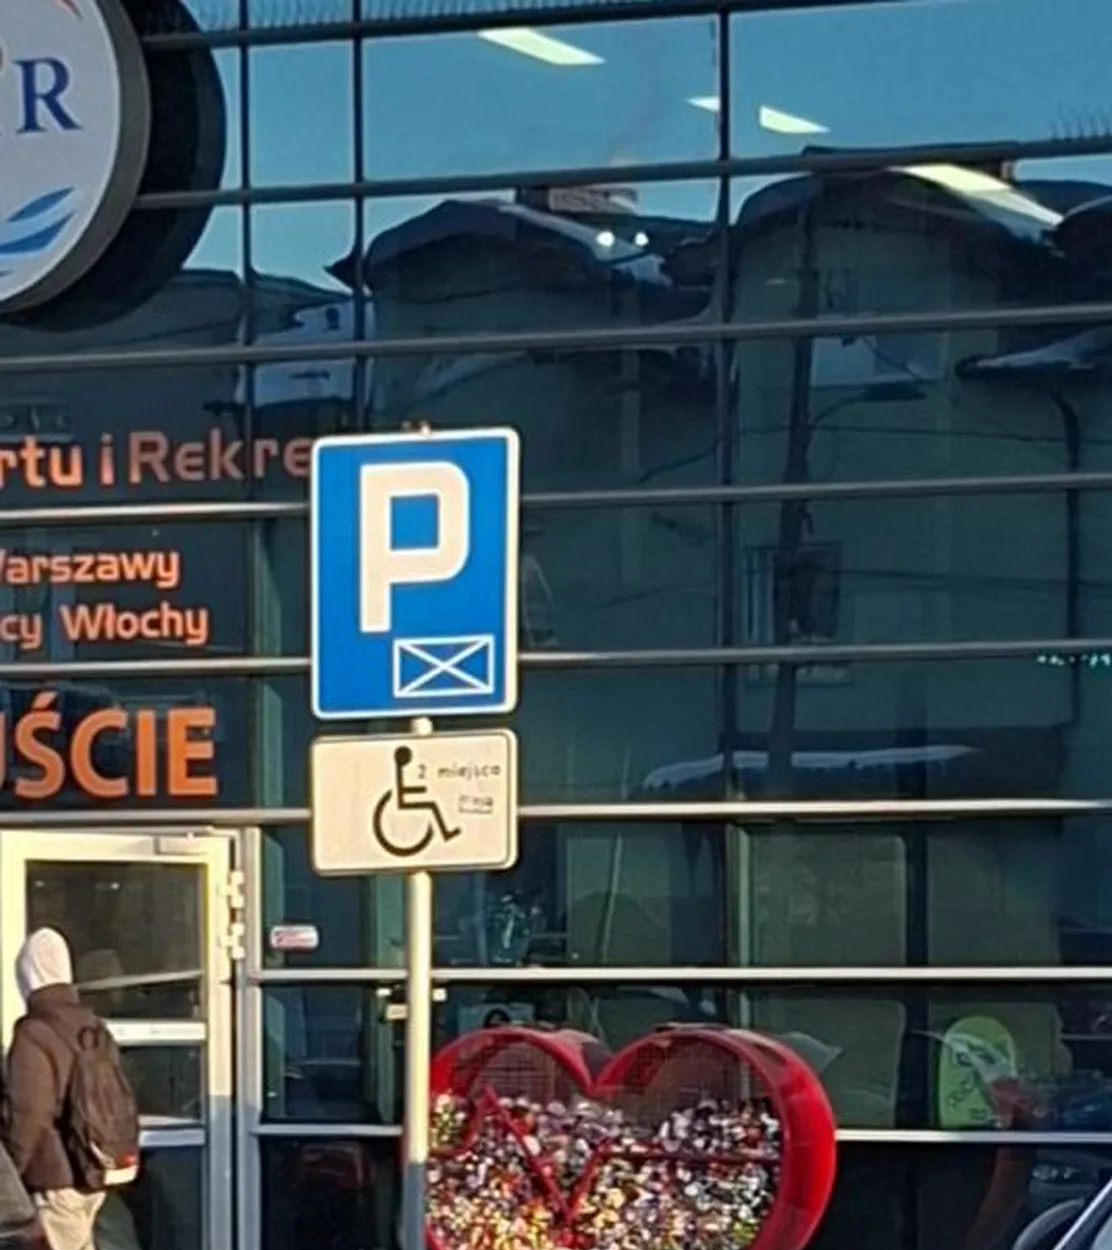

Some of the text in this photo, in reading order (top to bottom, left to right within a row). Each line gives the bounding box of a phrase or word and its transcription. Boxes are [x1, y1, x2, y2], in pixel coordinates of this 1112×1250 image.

[101, 432, 114, 485] i
[0, 551, 180, 588] arszawy
[360, 461, 470, 633] P
[59, 602, 209, 645] Włochy
[0, 691, 217, 798] ŚCIE
[418, 764, 427, 780] 2
